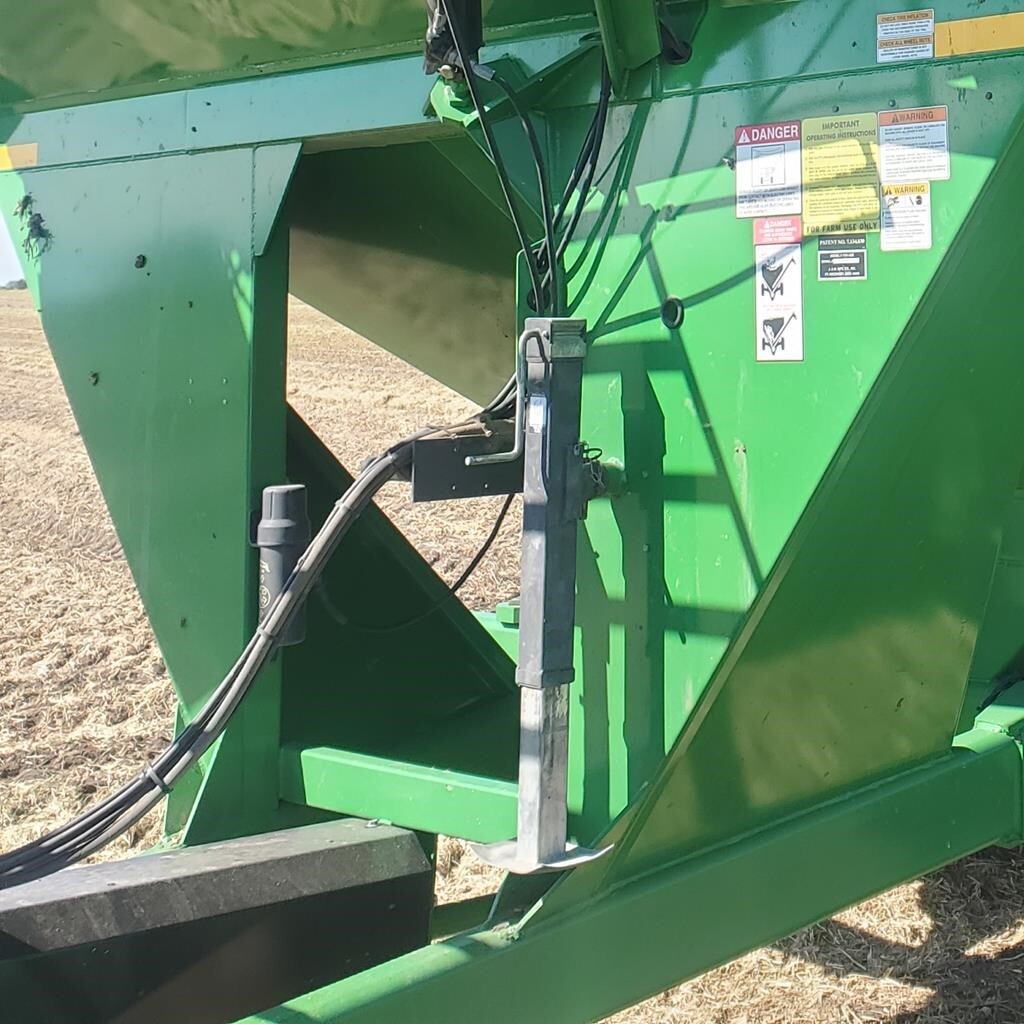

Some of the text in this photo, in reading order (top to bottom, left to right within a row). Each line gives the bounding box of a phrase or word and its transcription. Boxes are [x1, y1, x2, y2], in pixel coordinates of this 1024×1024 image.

[900, 111, 934, 122] WARNING
[822, 120, 860, 130] IMPORTANT
[752, 125, 798, 142] DANGER
[806, 129, 876, 141] OPERATING INSTRUCTIONS
[894, 185, 925, 194] WARNING
[822, 224, 841, 233] FARM
[843, 223, 857, 231] USE
[860, 221, 877, 230] ONLY
